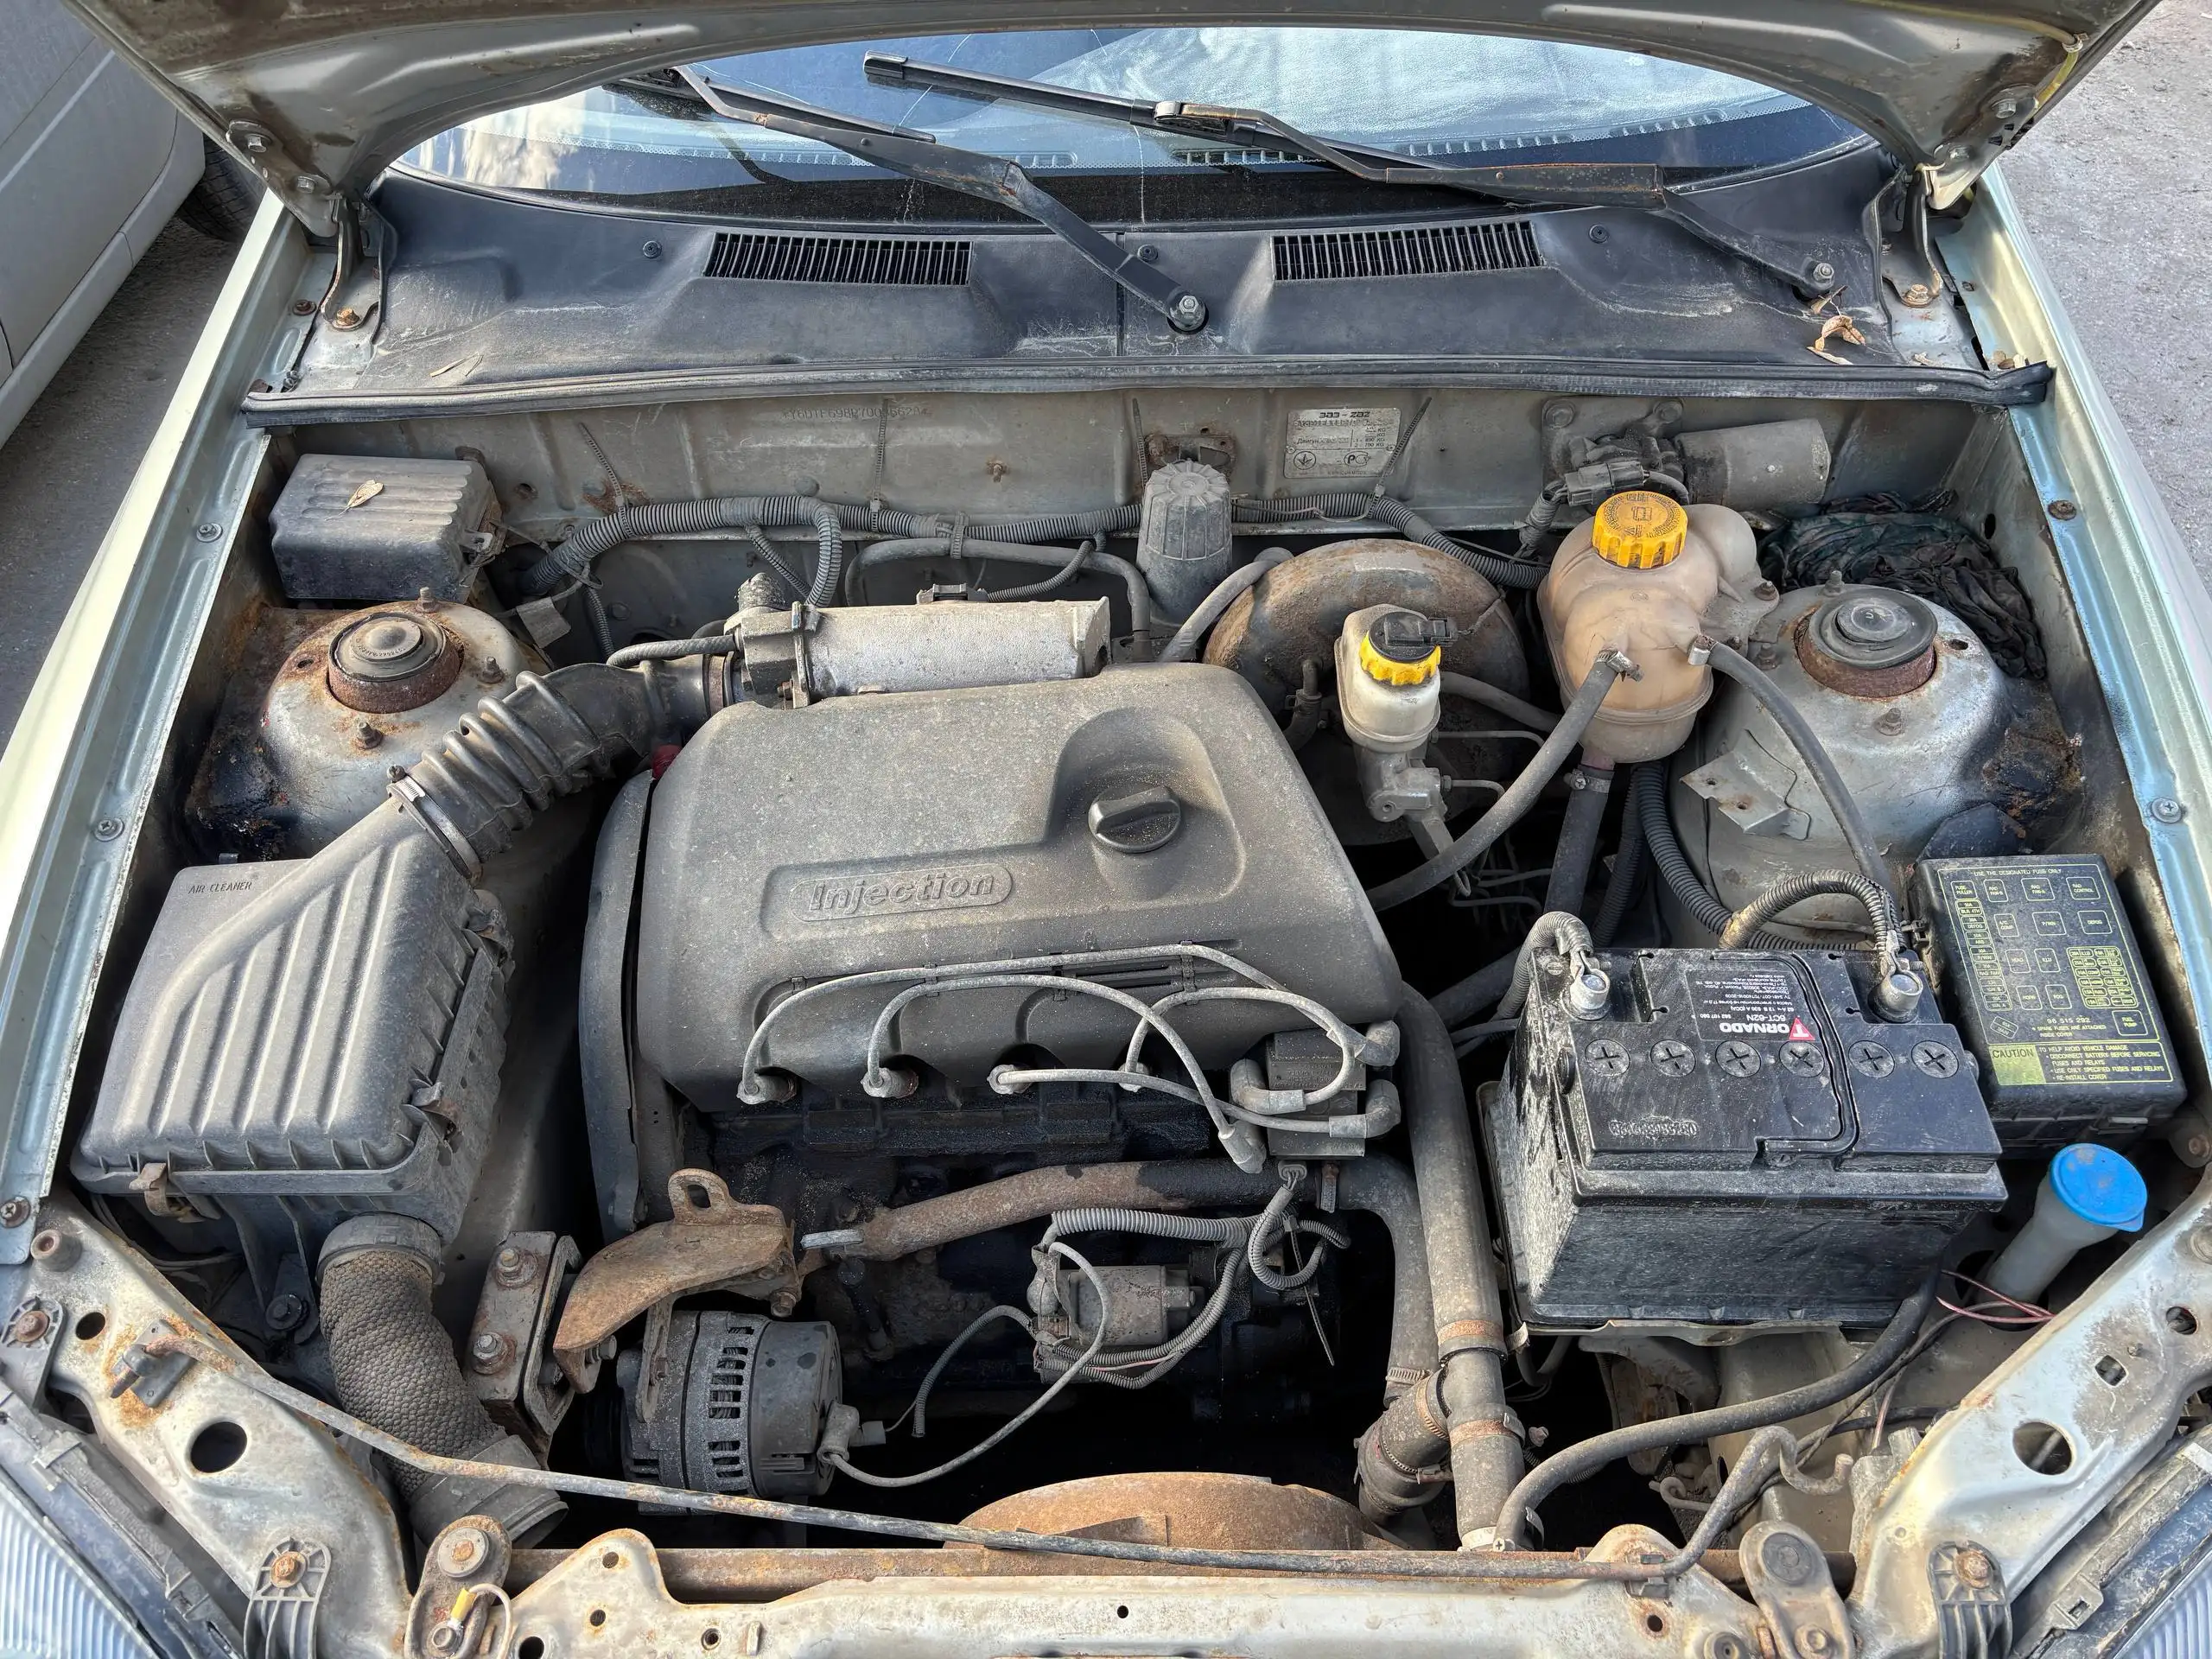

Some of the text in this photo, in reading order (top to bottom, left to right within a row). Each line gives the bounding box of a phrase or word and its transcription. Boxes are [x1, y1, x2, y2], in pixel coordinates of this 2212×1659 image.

[188, 881, 252, 894] AIR CLEANER
[809, 872, 995, 915] Injection
[1719, 1022, 1809, 1037] TORNADO
[1992, 1047, 2034, 1059] CAUTION
